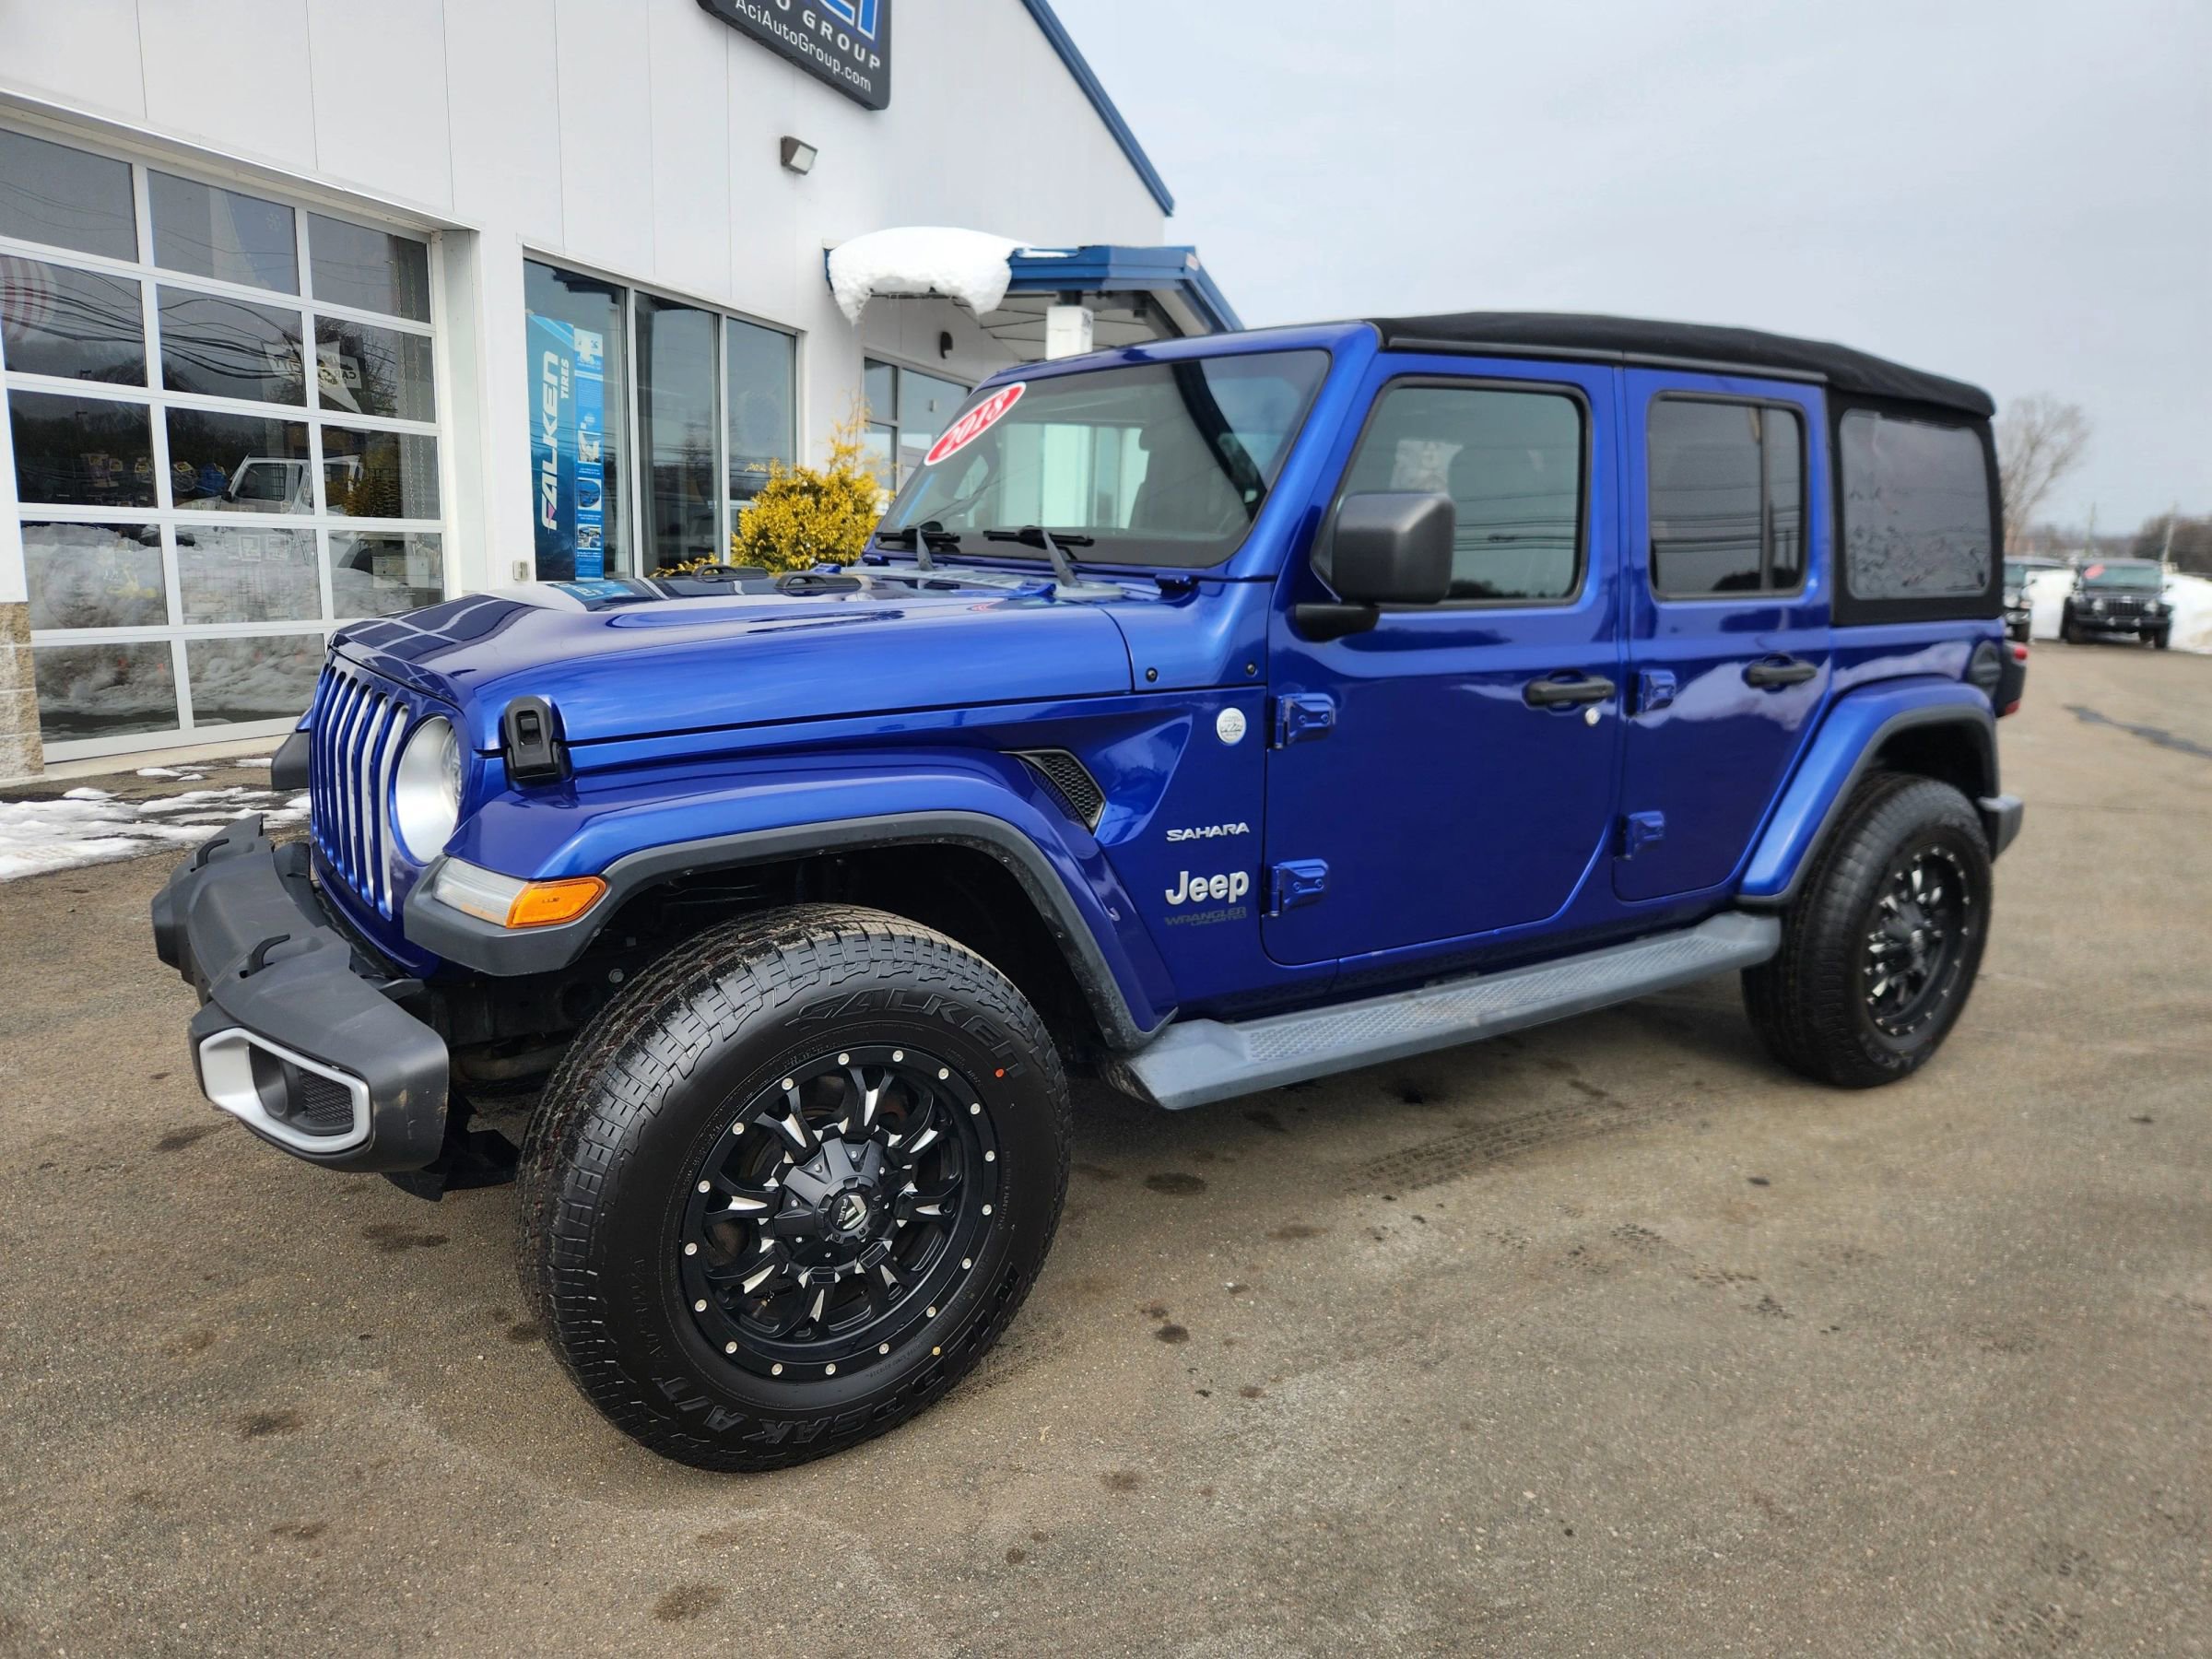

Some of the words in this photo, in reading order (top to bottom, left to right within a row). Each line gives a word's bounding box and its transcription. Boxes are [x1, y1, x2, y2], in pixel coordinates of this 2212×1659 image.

[735, 0, 872, 93] AciAutoGroup.com
[802, 9, 881, 70] GROUP
[560, 357, 570, 399] TIRES
[541, 350, 559, 531] FALKEN
[1166, 822, 1250, 841] SAHARA
[1165, 871, 1250, 905] Jeep
[1164, 907, 1247, 926] WRANGLER
[785, 987, 1026, 1079] FALKEN
[836, 1198, 848, 1226] FUEL
